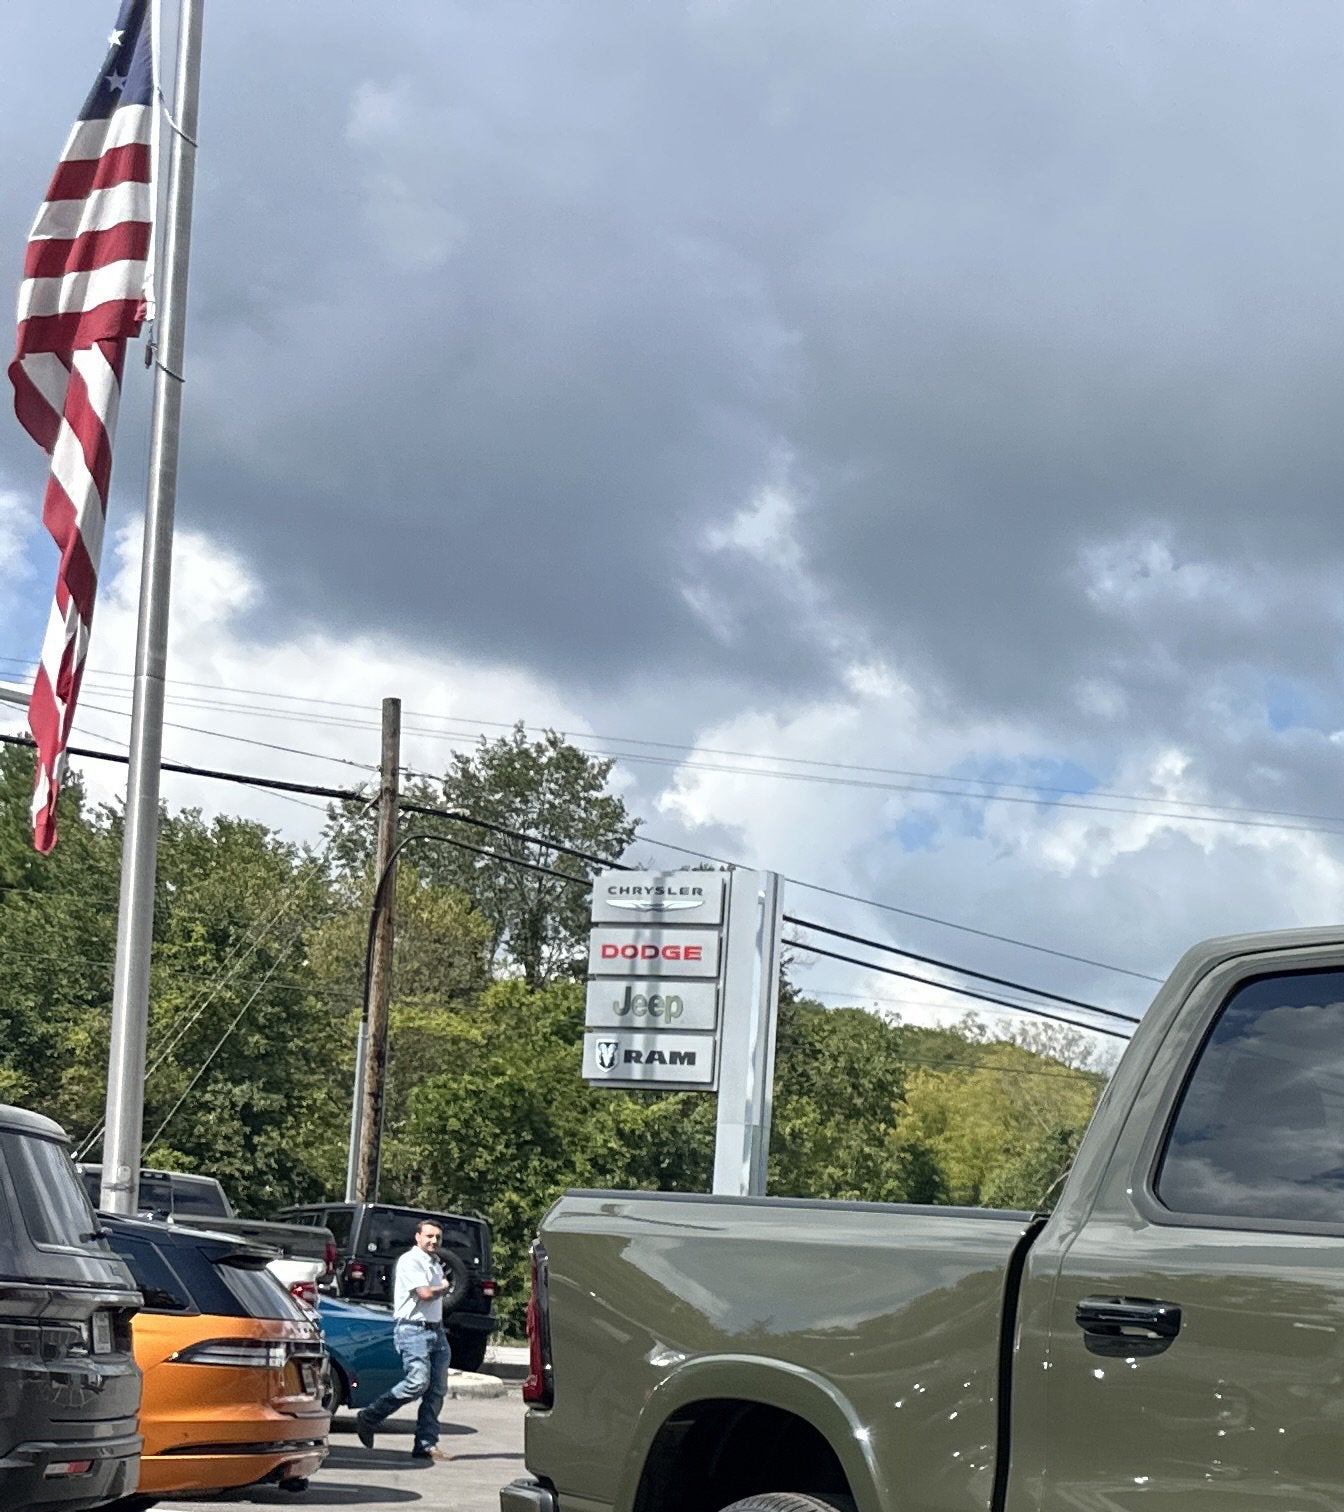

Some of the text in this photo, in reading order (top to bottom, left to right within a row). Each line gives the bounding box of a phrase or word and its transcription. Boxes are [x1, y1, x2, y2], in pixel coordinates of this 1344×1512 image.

[607, 885, 704, 897] CHRYSLER
[600, 943, 703, 961] DODGE
[612, 985, 684, 1023] Jeep
[623, 1049, 697, 1066] RAM
